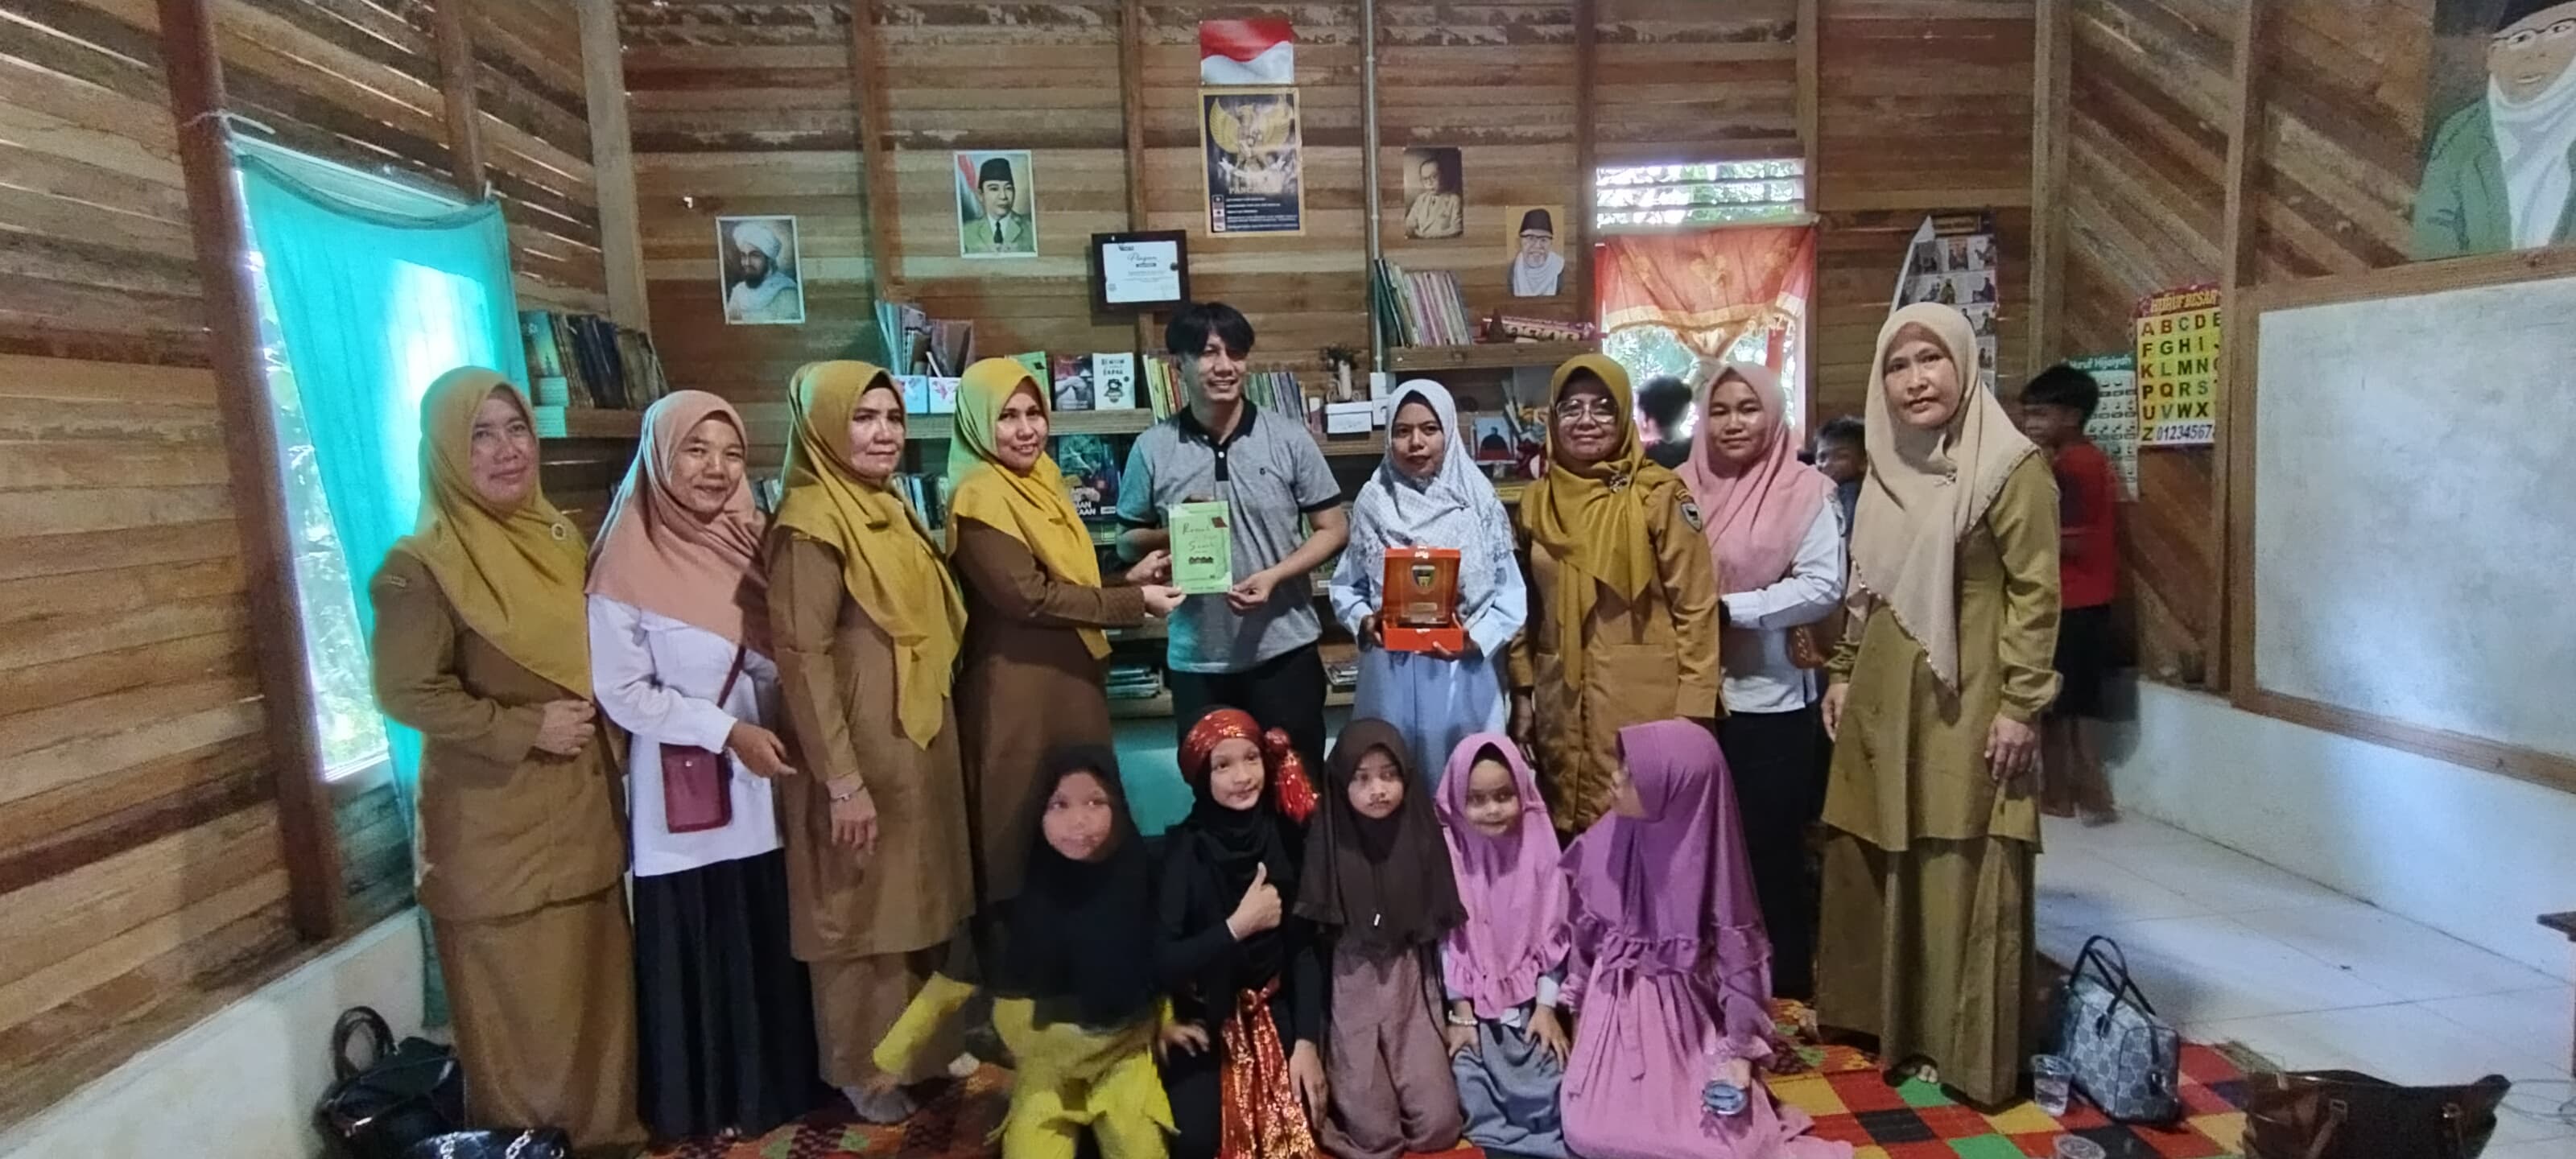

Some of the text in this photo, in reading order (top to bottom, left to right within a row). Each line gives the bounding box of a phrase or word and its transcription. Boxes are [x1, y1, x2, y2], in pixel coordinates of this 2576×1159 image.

[2141, 322, 2154, 336] A
[2161, 320, 2172, 334] B
[2178, 316, 2189, 331] C
[2195, 314, 2206, 329] D
[2142, 343, 2153, 357] F
[2160, 340, 2173, 355] G
[2178, 338, 2190, 353] H
[2198, 336, 2203, 352] I
[2140, 362, 2154, 379] K
[2161, 361, 2172, 377] L
[2178, 359, 2192, 376] M
[2196, 357, 2208, 373] N
[2142, 385, 2153, 400] P
[2160, 382, 2174, 398] Q
[2178, 382, 2191, 397] R
[2198, 380, 2209, 395] S
[2143, 405, 2155, 420] U
[2161, 403, 2174, 419] V
[2178, 402, 2192, 419] W
[2195, 402, 2208, 418] X
[2142, 427, 2154, 441] Z
[2156, 424, 2215, 441] 01234567
